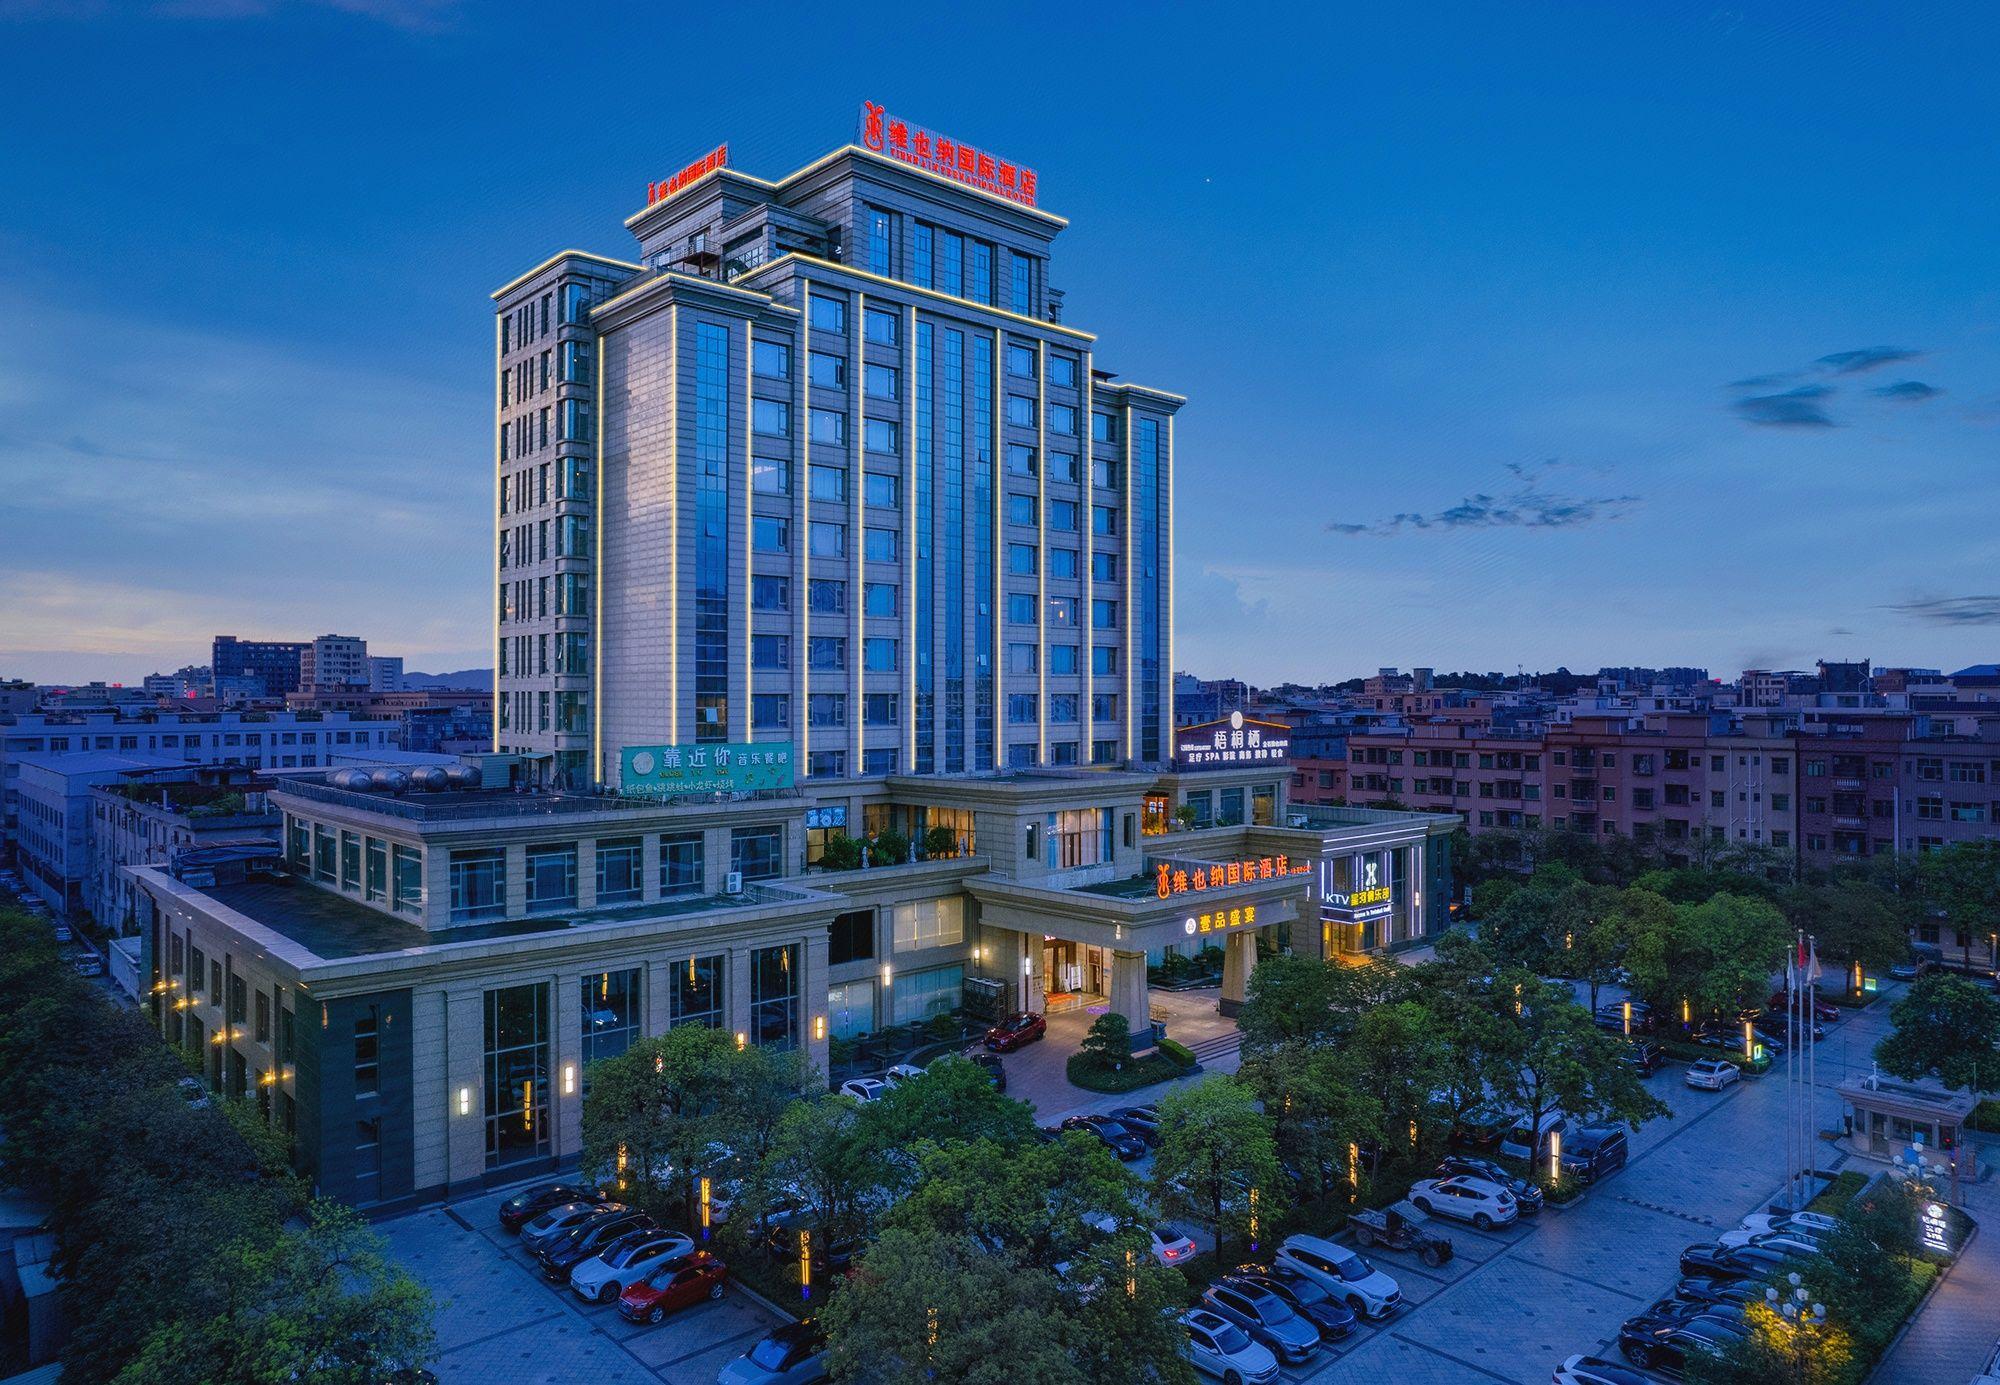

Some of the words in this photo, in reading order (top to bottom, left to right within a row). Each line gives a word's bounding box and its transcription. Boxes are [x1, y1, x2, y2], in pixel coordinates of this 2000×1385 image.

[888, 119, 1037, 197] 维也纳国际酒店
[663, 746, 731, 769] 靠近你
[737, 751, 789, 766] 音乐餐吧
[1205, 752, 1220, 761] SPA
[1173, 853, 1289, 893] 维也纳国际酒店
[1326, 892, 1349, 905] KTV
[1199, 906, 1256, 932] 壹品盛宴
